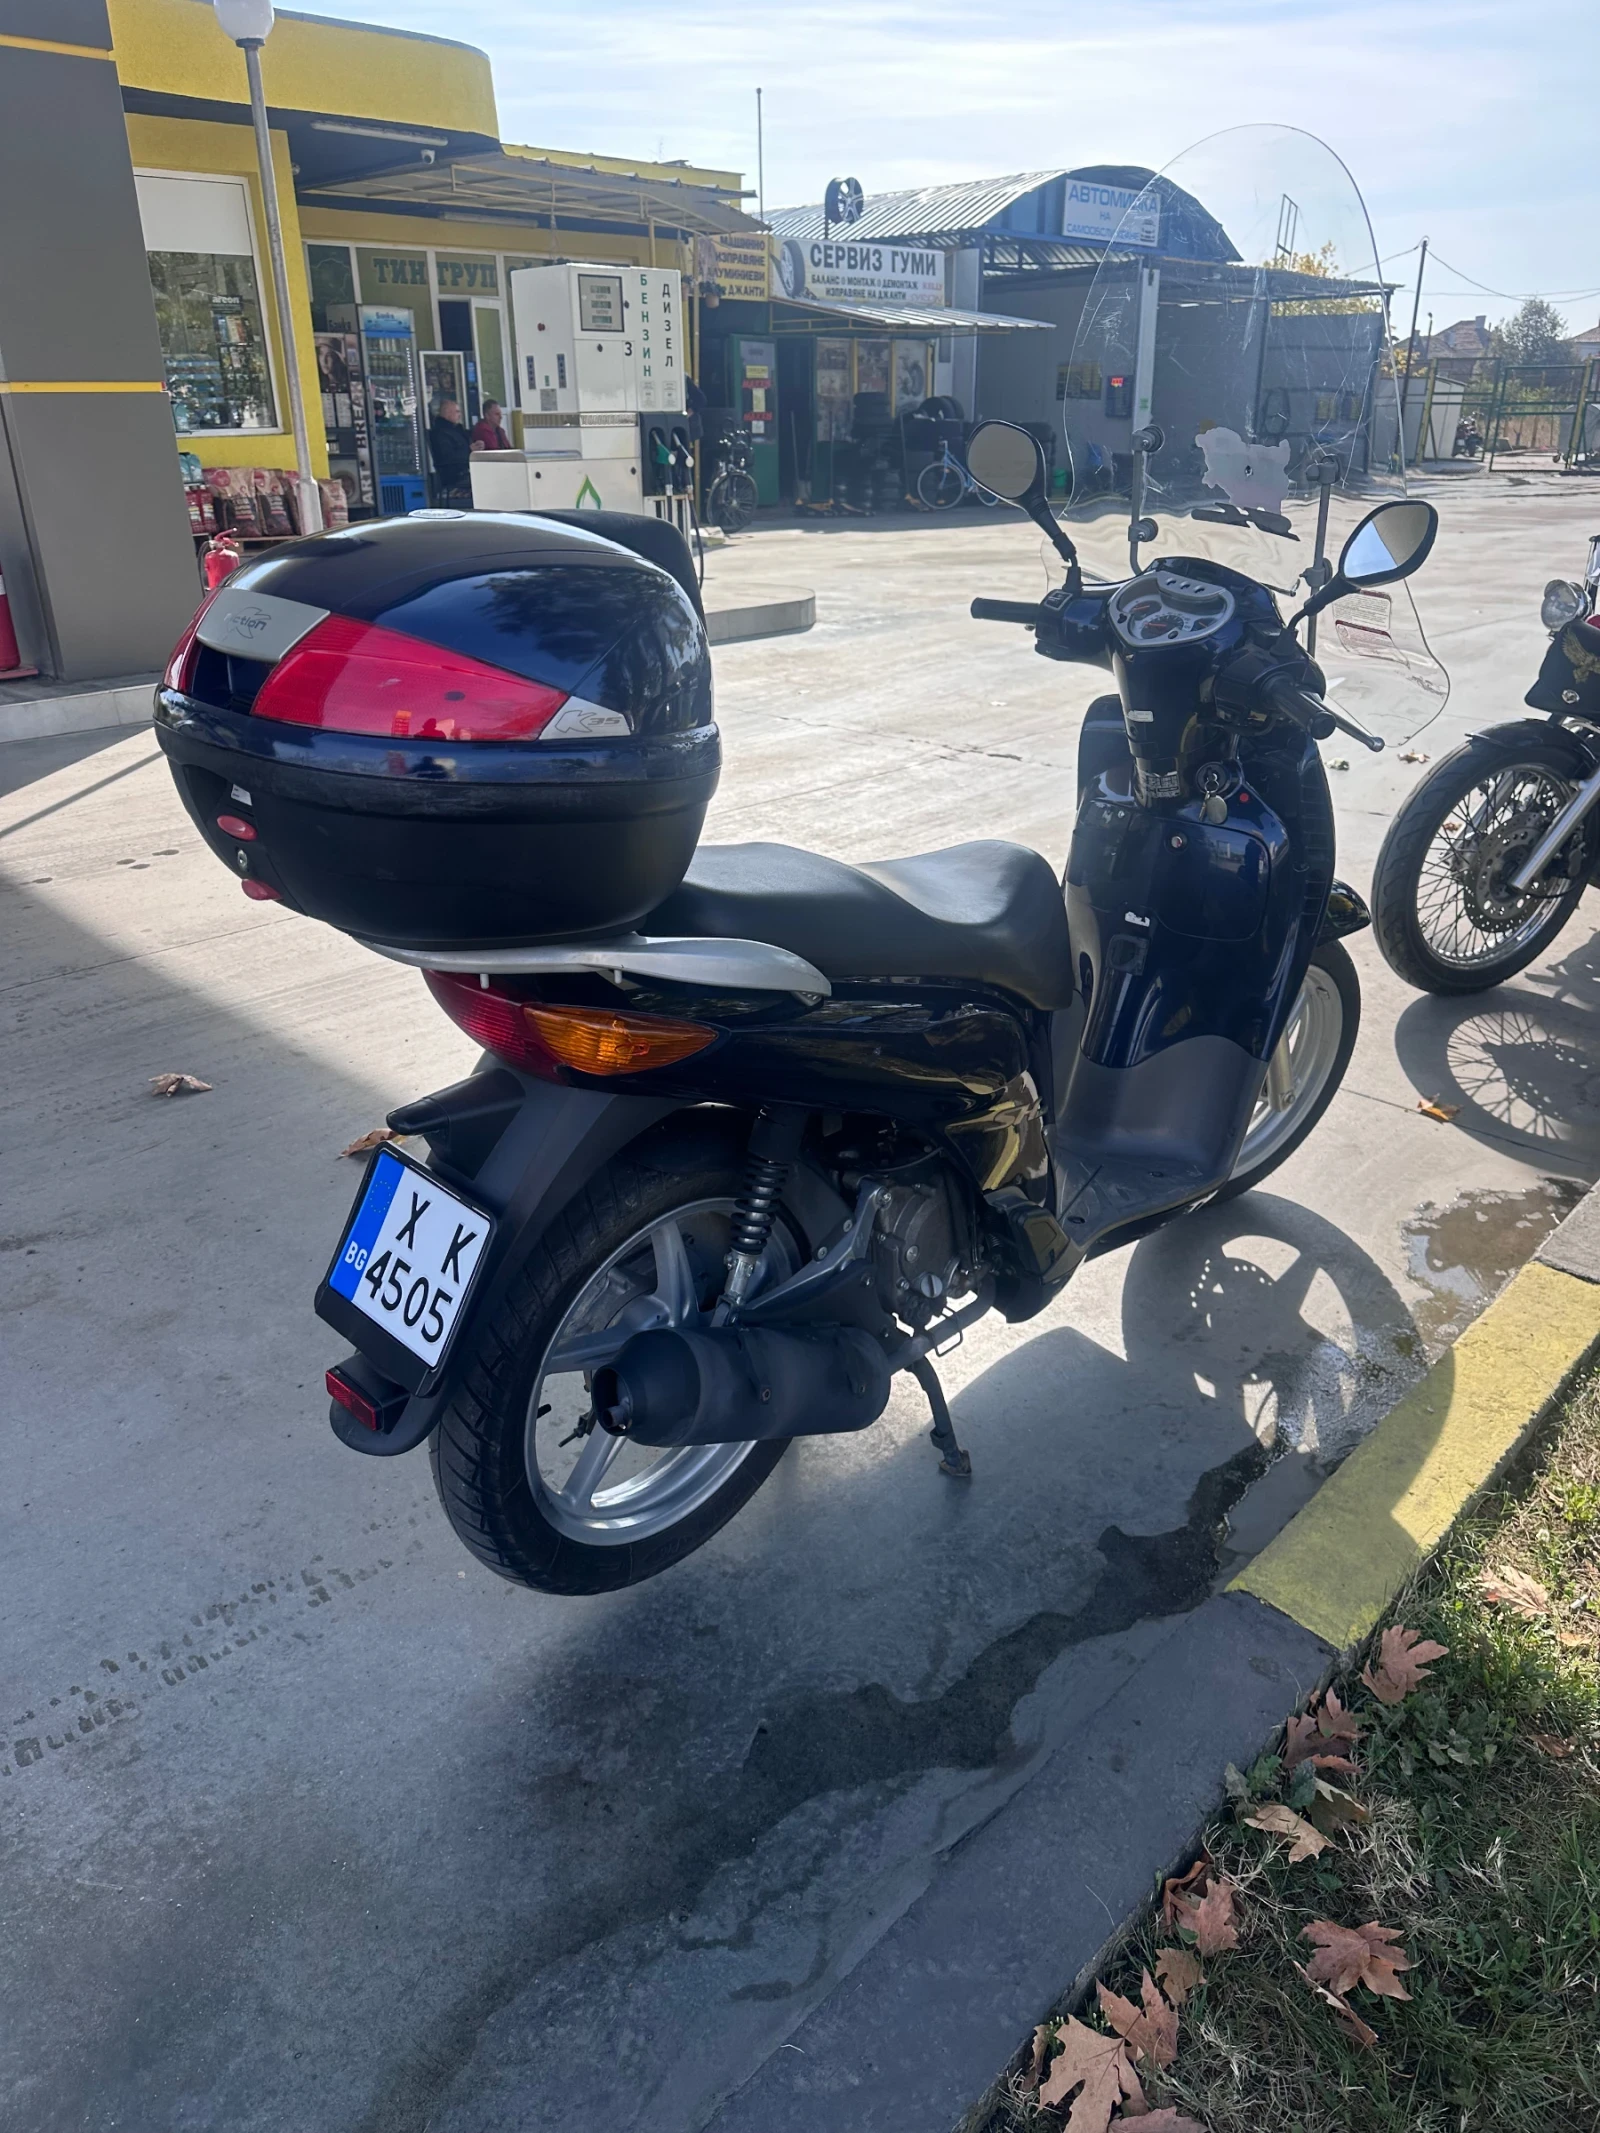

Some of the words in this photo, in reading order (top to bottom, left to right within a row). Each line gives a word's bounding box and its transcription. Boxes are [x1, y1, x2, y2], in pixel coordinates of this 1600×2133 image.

[1068, 184, 1158, 212] АВТОМИКА
[373, 257, 428, 285] ТИН
[436, 261, 496, 288] ГРУП
[810, 242, 883, 272] СЕРВИЗ
[891, 250, 937, 276] ГУМИ
[728, 284, 766, 298] ДЖАНТИ
[811, 274, 840, 285] БАЛАНС
[847, 276, 876, 287] МОНТАЖ
[882, 279, 919, 290] ДЕМОНТАЖ
[825, 287, 866, 298] ИЗПРАВЯНЕ
[867, 289, 877, 299] НА
[878, 289, 906, 300] ДЖАНТИ
[639, 273, 653, 378] БЕНЗИН
[662, 283, 674, 368] ДИЗЕЛ
[624, 341, 633, 357] 3
[395, 1191, 431, 1250] X
[440, 1222, 478, 1285] K
[344, 1240, 368, 1271] BG
[365, 1250, 454, 1343] 4505
